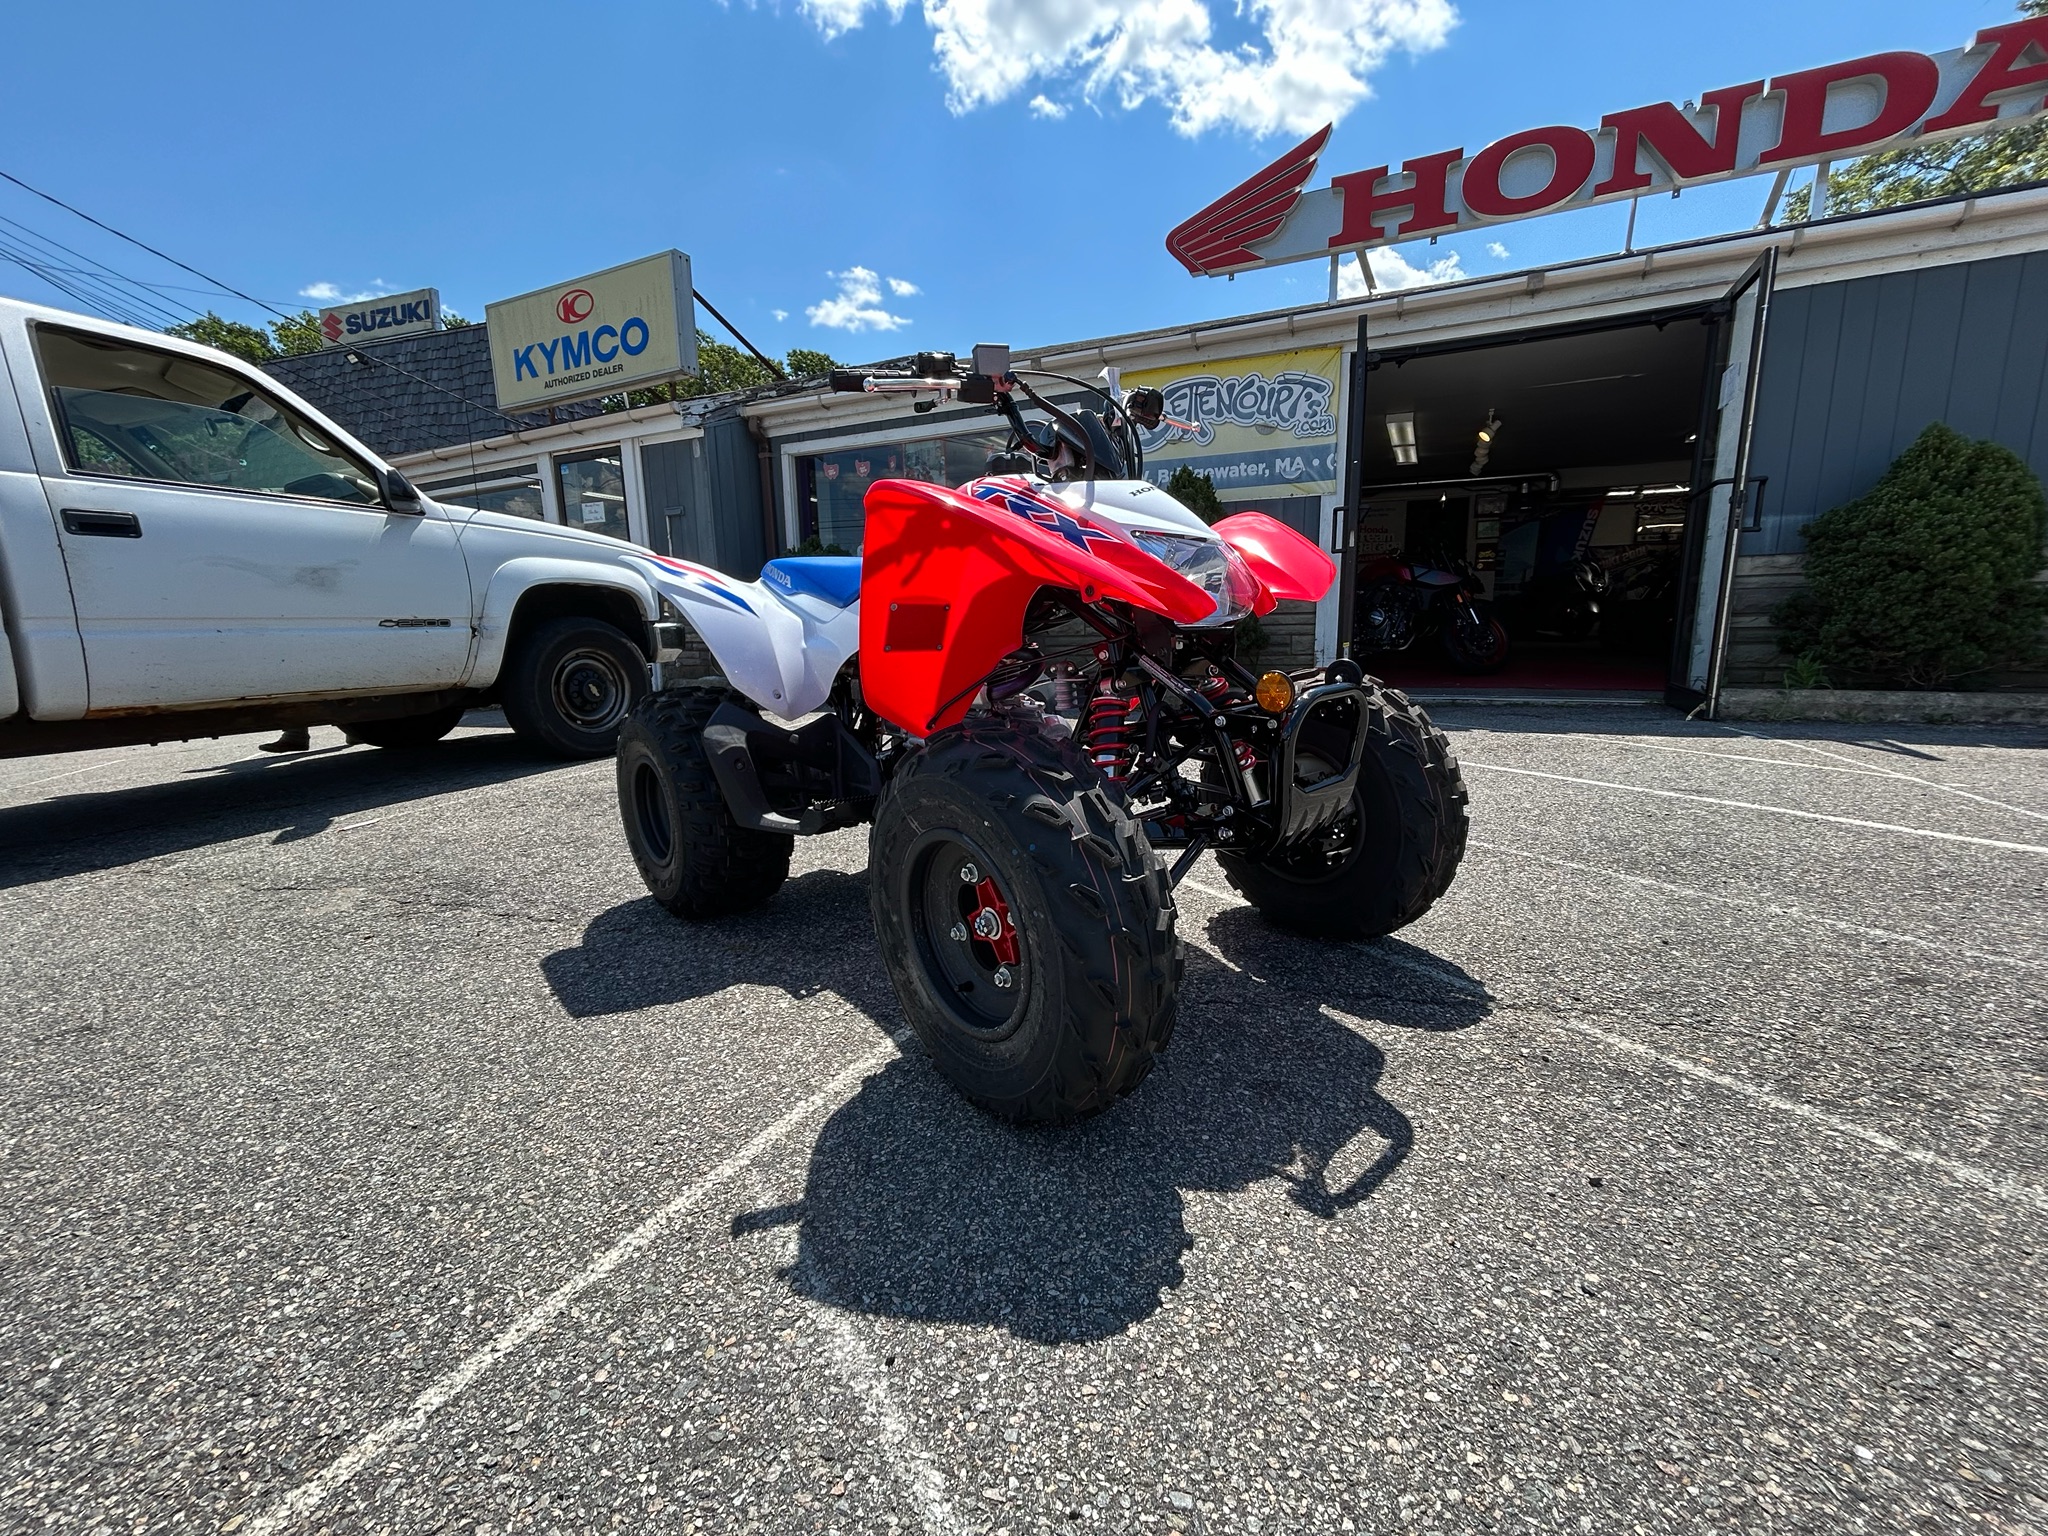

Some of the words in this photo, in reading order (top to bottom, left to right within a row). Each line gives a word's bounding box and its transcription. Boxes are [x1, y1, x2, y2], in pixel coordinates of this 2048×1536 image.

[1328, 15, 2048, 249] HONDA
[345, 299, 431, 335] SUZUKI
[513, 316, 650, 382] KYMCO
[544, 371, 591, 390] AUTHORIZED
[592, 363, 624, 378] DEALER
[1275, 456, 1306, 473] MA
[763, 562, 792, 589] HONDA
[398, 618, 451, 628] 2500
